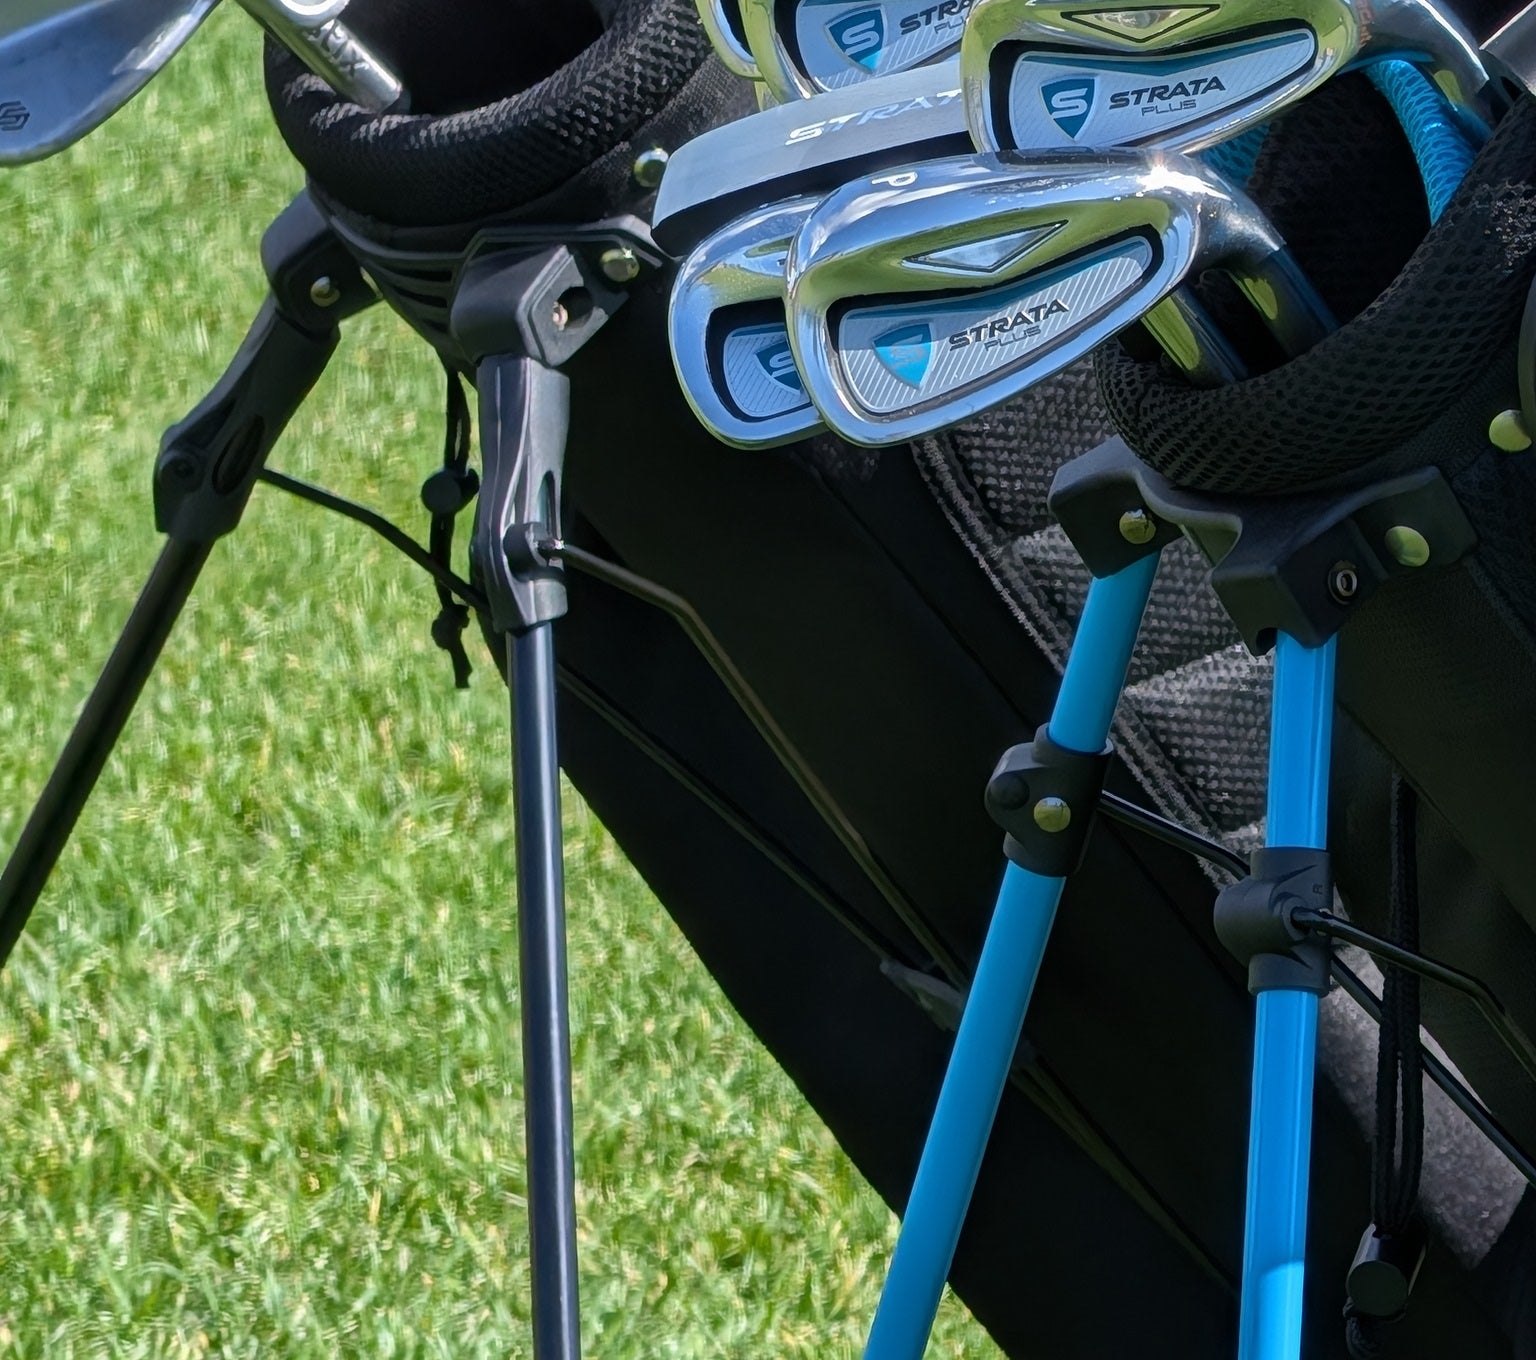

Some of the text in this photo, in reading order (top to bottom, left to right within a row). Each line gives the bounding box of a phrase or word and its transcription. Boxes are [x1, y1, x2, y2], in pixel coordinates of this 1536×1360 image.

[1109, 76, 1226, 110] STRATA
[1141, 99, 1196, 117] PLUS
[949, 298, 1070, 351] STRATA
[983, 326, 1041, 353] PLUS
